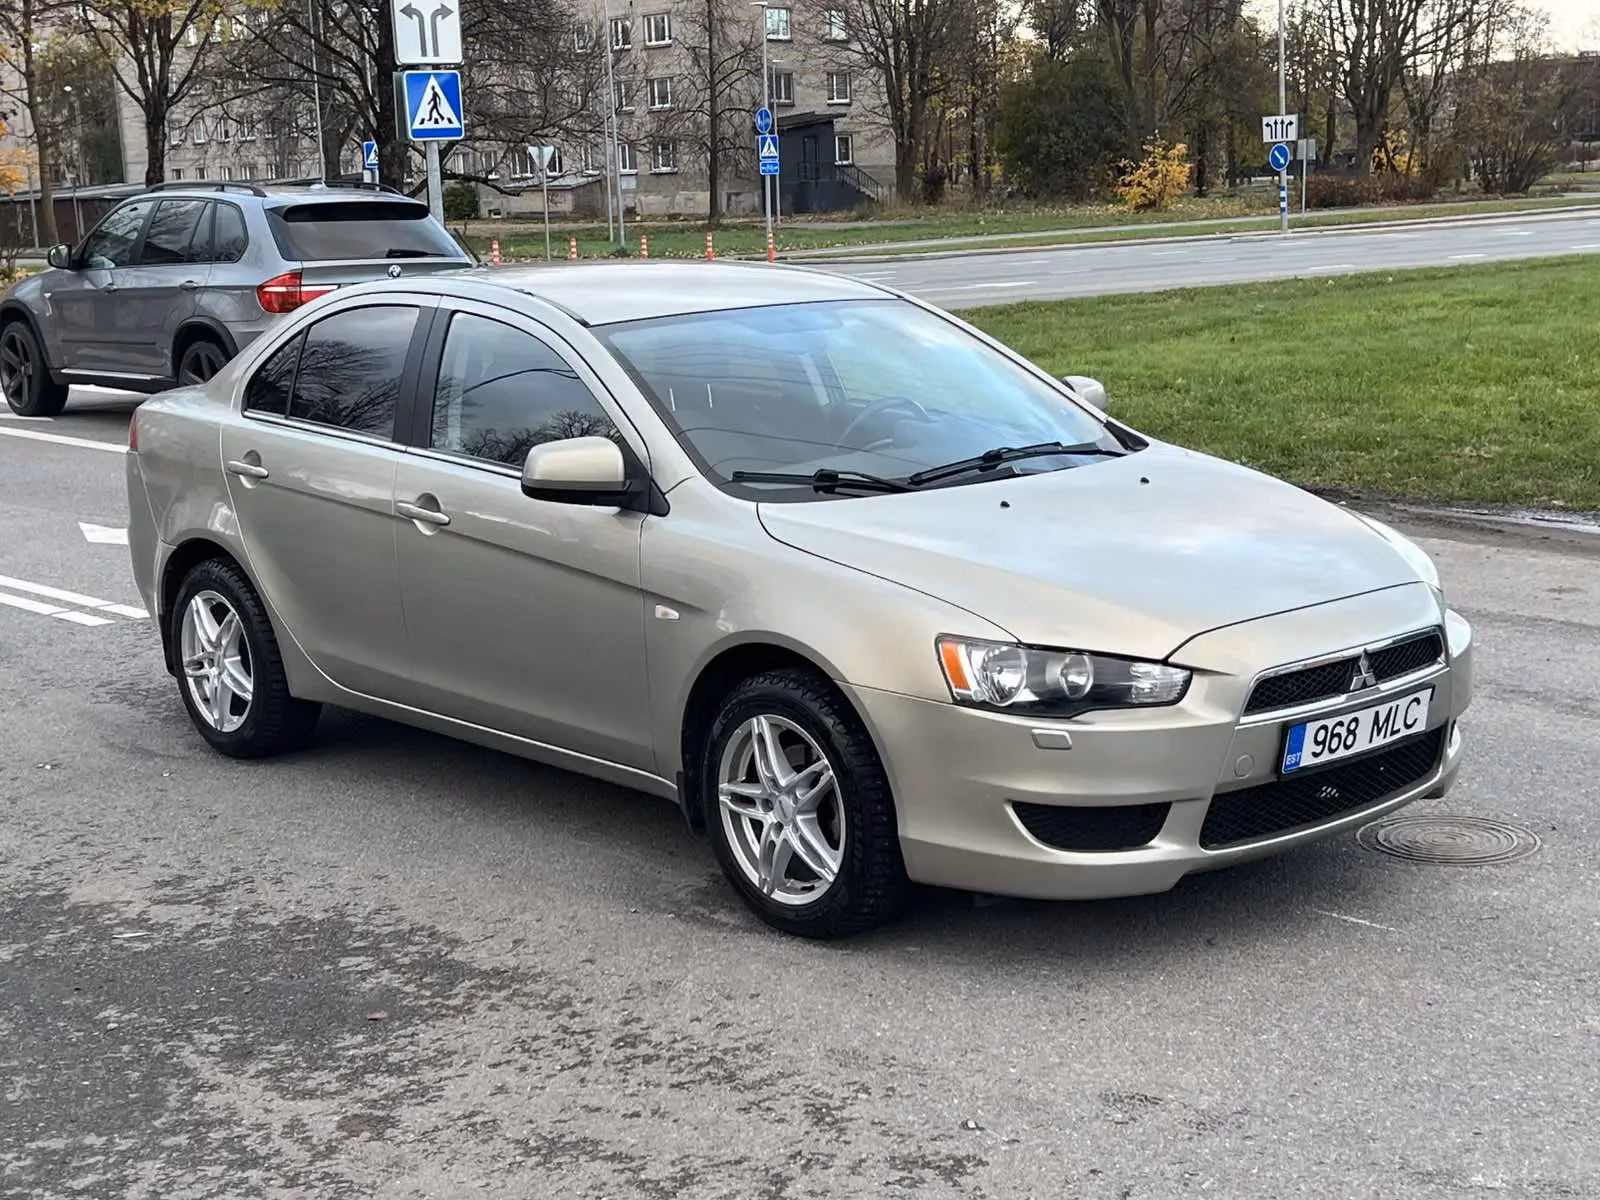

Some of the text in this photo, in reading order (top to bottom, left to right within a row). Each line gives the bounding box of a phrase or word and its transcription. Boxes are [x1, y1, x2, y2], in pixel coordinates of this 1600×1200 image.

[1311, 696, 1421, 758] 968 MLC
[1285, 752, 1301, 765] EST
